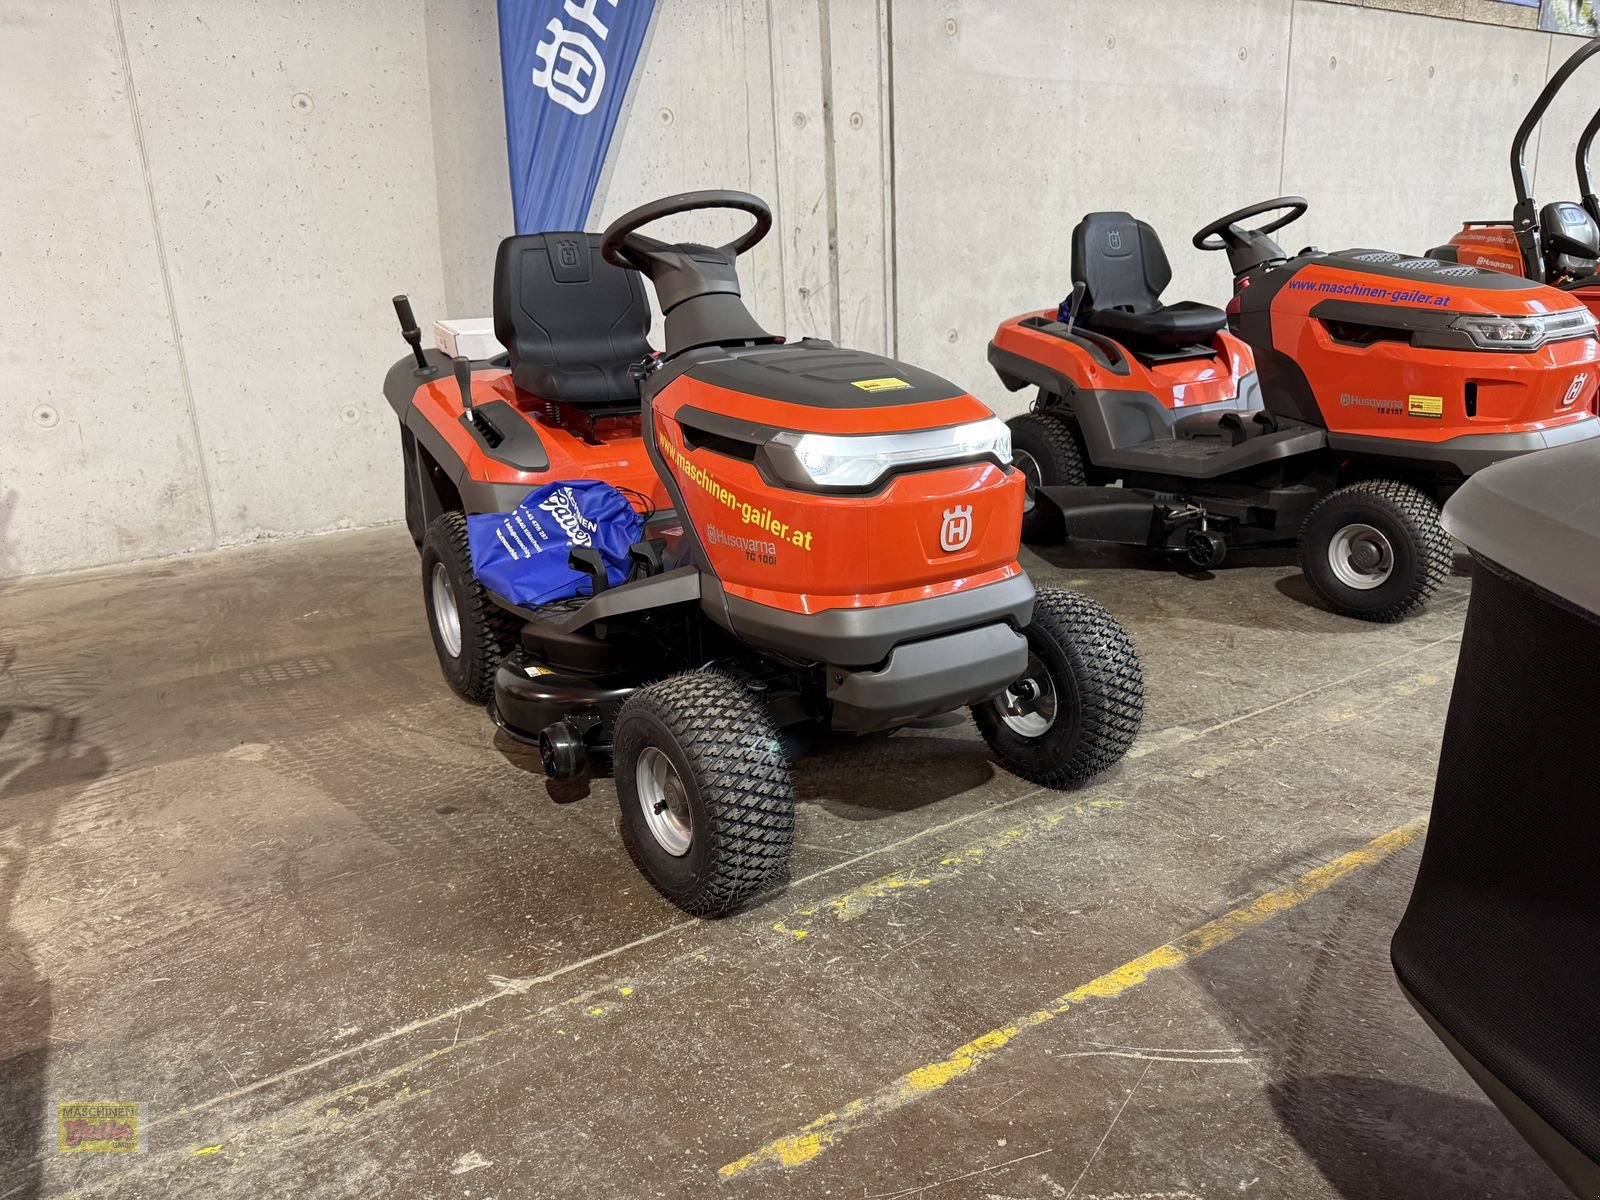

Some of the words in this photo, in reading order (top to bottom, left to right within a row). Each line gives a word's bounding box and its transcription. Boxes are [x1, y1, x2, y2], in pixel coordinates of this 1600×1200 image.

[1482, 258, 1514, 270] Husqvarna
[1289, 280, 1451, 306] www.maschinen-gailer.at
[1350, 395, 1403, 409] Husqvarna
[659, 431, 813, 551] www.maschinen-gailer.at
[716, 528, 777, 554] Husqvarna
[745, 552, 755, 561] TC
[758, 554, 777, 565] 100i
